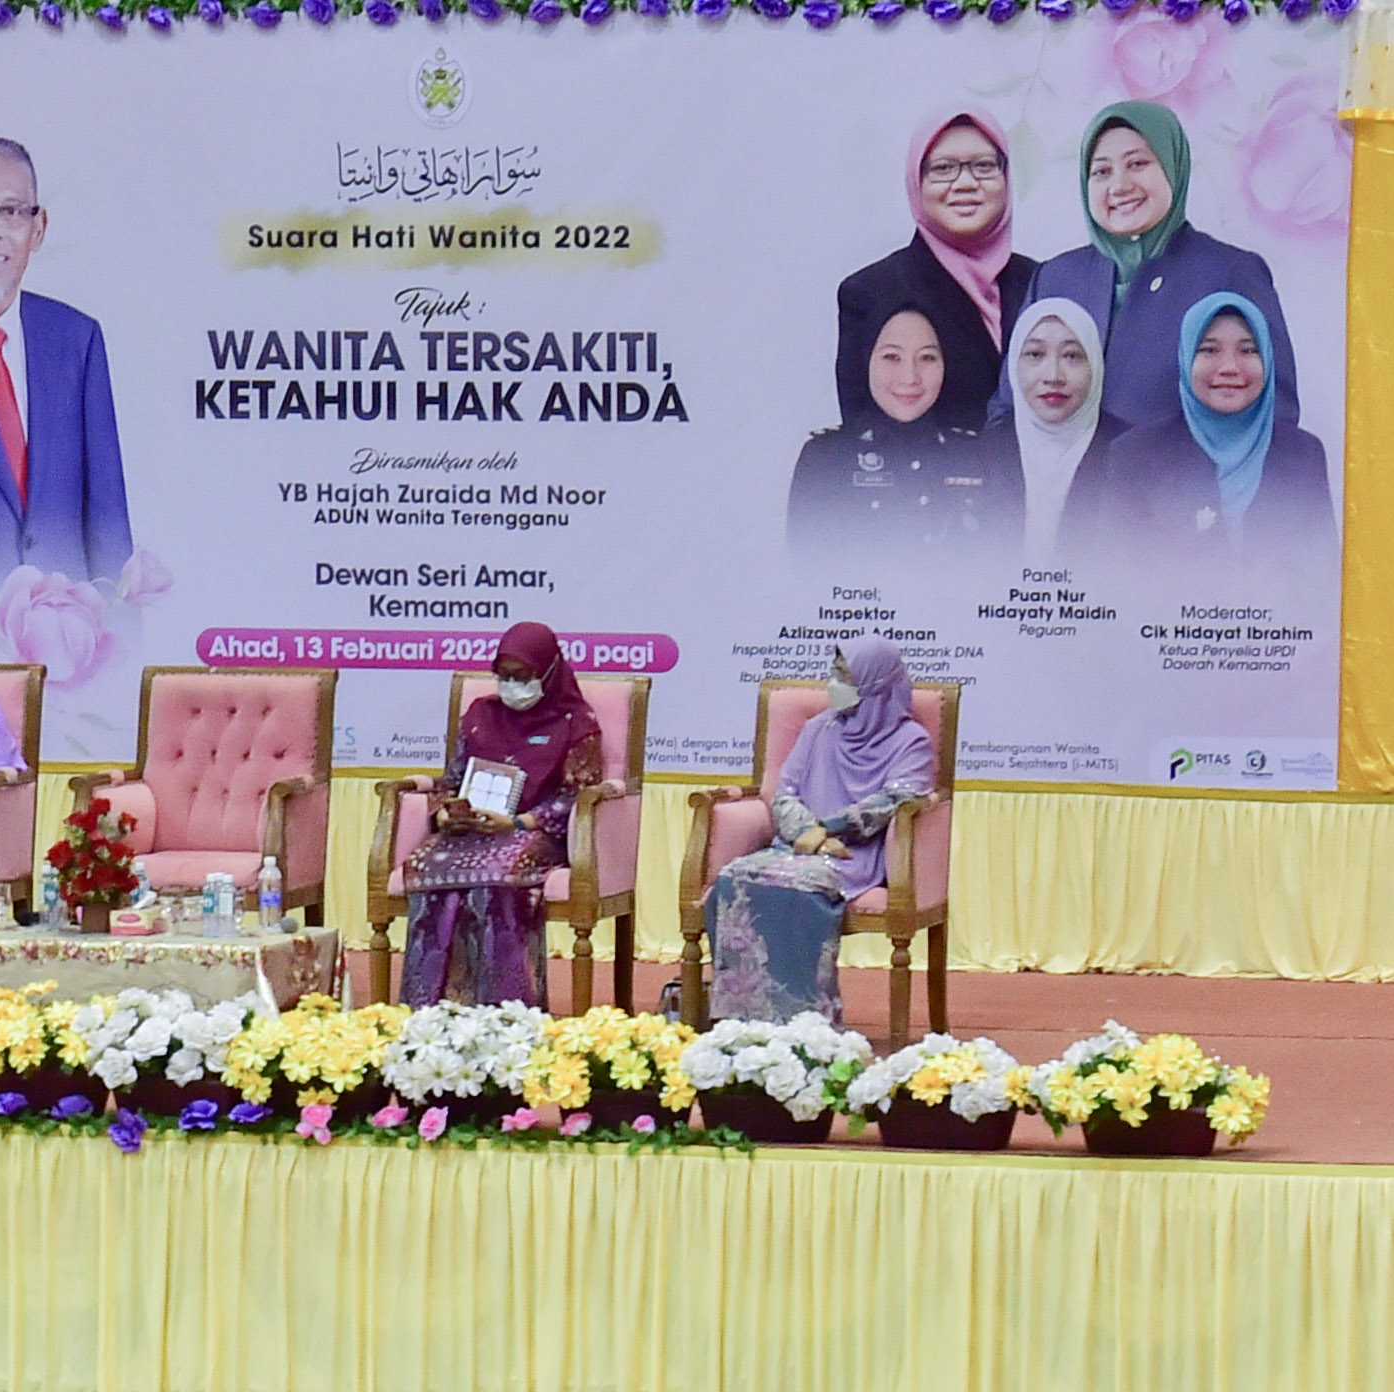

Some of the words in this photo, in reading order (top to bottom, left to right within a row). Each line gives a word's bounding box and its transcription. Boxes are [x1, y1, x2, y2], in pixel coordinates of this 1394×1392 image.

[248, 225, 338, 249] Suara
[352, 225, 415, 249] Hati
[428, 225, 541, 249] Wanita
[554, 225, 631, 249] 2022
[207, 329, 405, 372] WANITA
[420, 331, 674, 380] TERSAKITI,
[195, 380, 397, 421] KETAHUI
[416, 381, 523, 422] HAK
[539, 382, 690, 423] ANDA
[349, 448, 472, 475] Dirasmikan
[477, 450, 519, 471] oleh
[278, 483, 308, 502] YB
[317, 483, 390, 508] Hajah
[398, 484, 491, 504] Zuraida
[500, 485, 537, 505] Md
[547, 486, 607, 506] Noor
[314, 508, 369, 525] ADUN
[376, 510, 445, 526] Wanita
[451, 510, 569, 530] Terengganu
[315, 563, 409, 586] Dewan
[417, 564, 466, 587] Seri
[474, 565, 554, 593] Amar,
[1009, 588, 1051, 602] Puan
[1057, 589, 1086, 602] Nur
[369, 594, 509, 618] Kemaman
[819, 606, 897, 622] Inspektor
[978, 605, 1054, 621] Hidayaty
[1059, 605, 1117, 620] Maidin
[1019, 623, 1076, 638] Peguam
[1140, 625, 1169, 639] Cik
[1174, 625, 1241, 642] Hidayat
[1247, 627, 1313, 641] Ibrahim
[208, 635, 286, 662] Ahad,
[294, 636, 324, 659] 13
[331, 637, 434, 660] Februari
[593, 641, 654, 669] pagi
[732, 644, 793, 657] Inspektor
[796, 644, 821, 656] D13
[954, 647, 984, 658] DNA
[1159, 644, 1198, 657] Ketua
[1201, 644, 1261, 658] Penyelia
[1264, 645, 1296, 657] UPDI
[762, 658, 828, 671] Bahagian
[1163, 658, 1214, 670] Daerah
[1218, 659, 1291, 671] Kemaman
[739, 671, 762, 682] Ibu
[391, 733, 440, 746] Anjuran
[681, 737, 729, 751] dengan
[961, 741, 1052, 755] Pembangunan
[1055, 742, 1100, 755] Wanita
[373, 746, 382, 758] &
[386, 747, 441, 761] Keluarga
[1008, 757, 1068, 771] Sejahtera
[1196, 753, 1231, 765] PITAS
